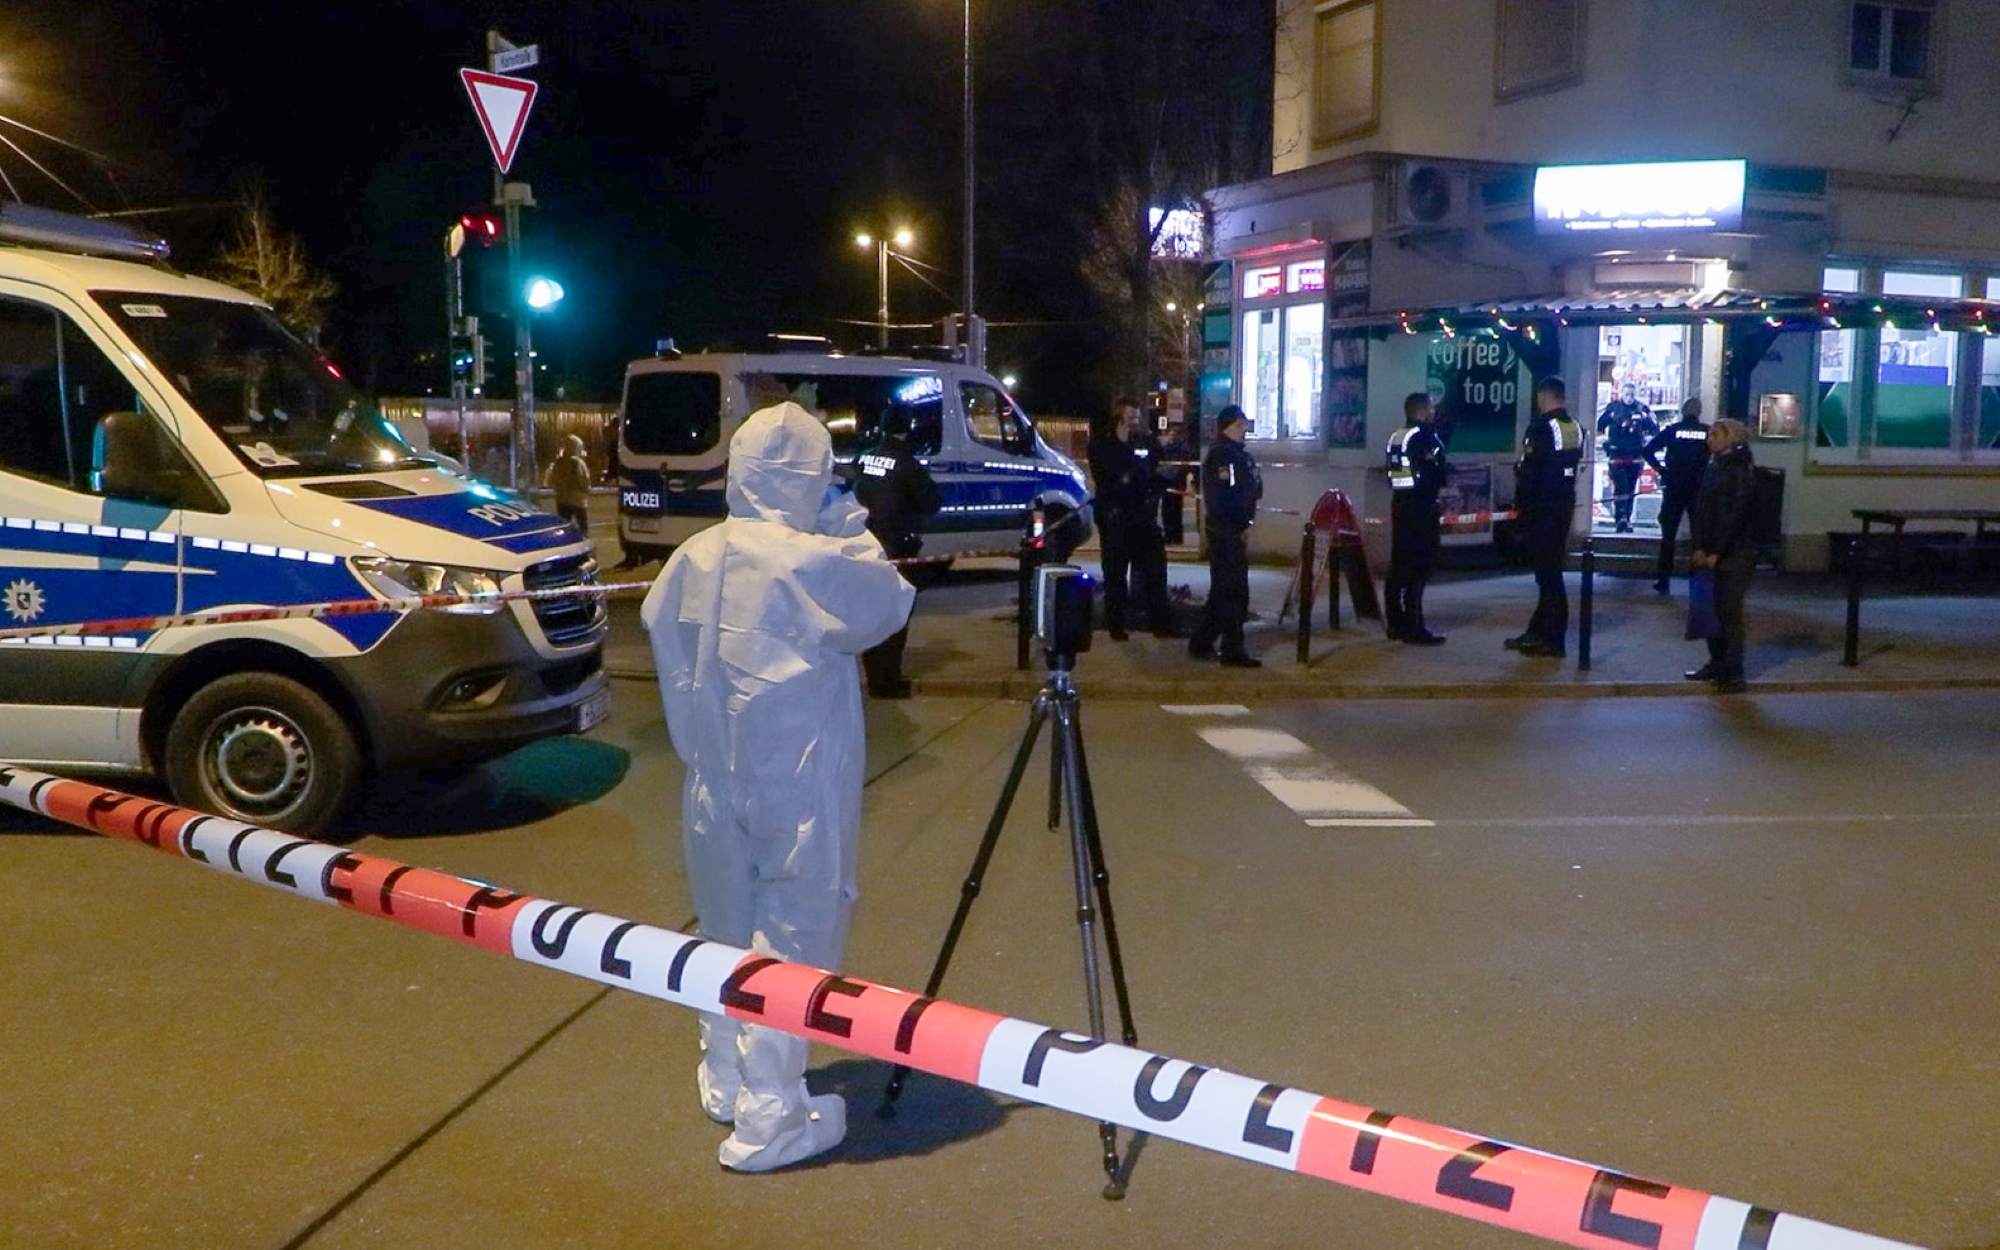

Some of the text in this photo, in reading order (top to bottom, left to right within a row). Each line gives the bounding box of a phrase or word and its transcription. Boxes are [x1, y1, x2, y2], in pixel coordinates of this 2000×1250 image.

[1463, 376, 1485, 404] to
[1489, 381, 1515, 412] go
[858, 454, 896, 470] POLIZEI
[623, 492, 659, 508] POLIZEI
